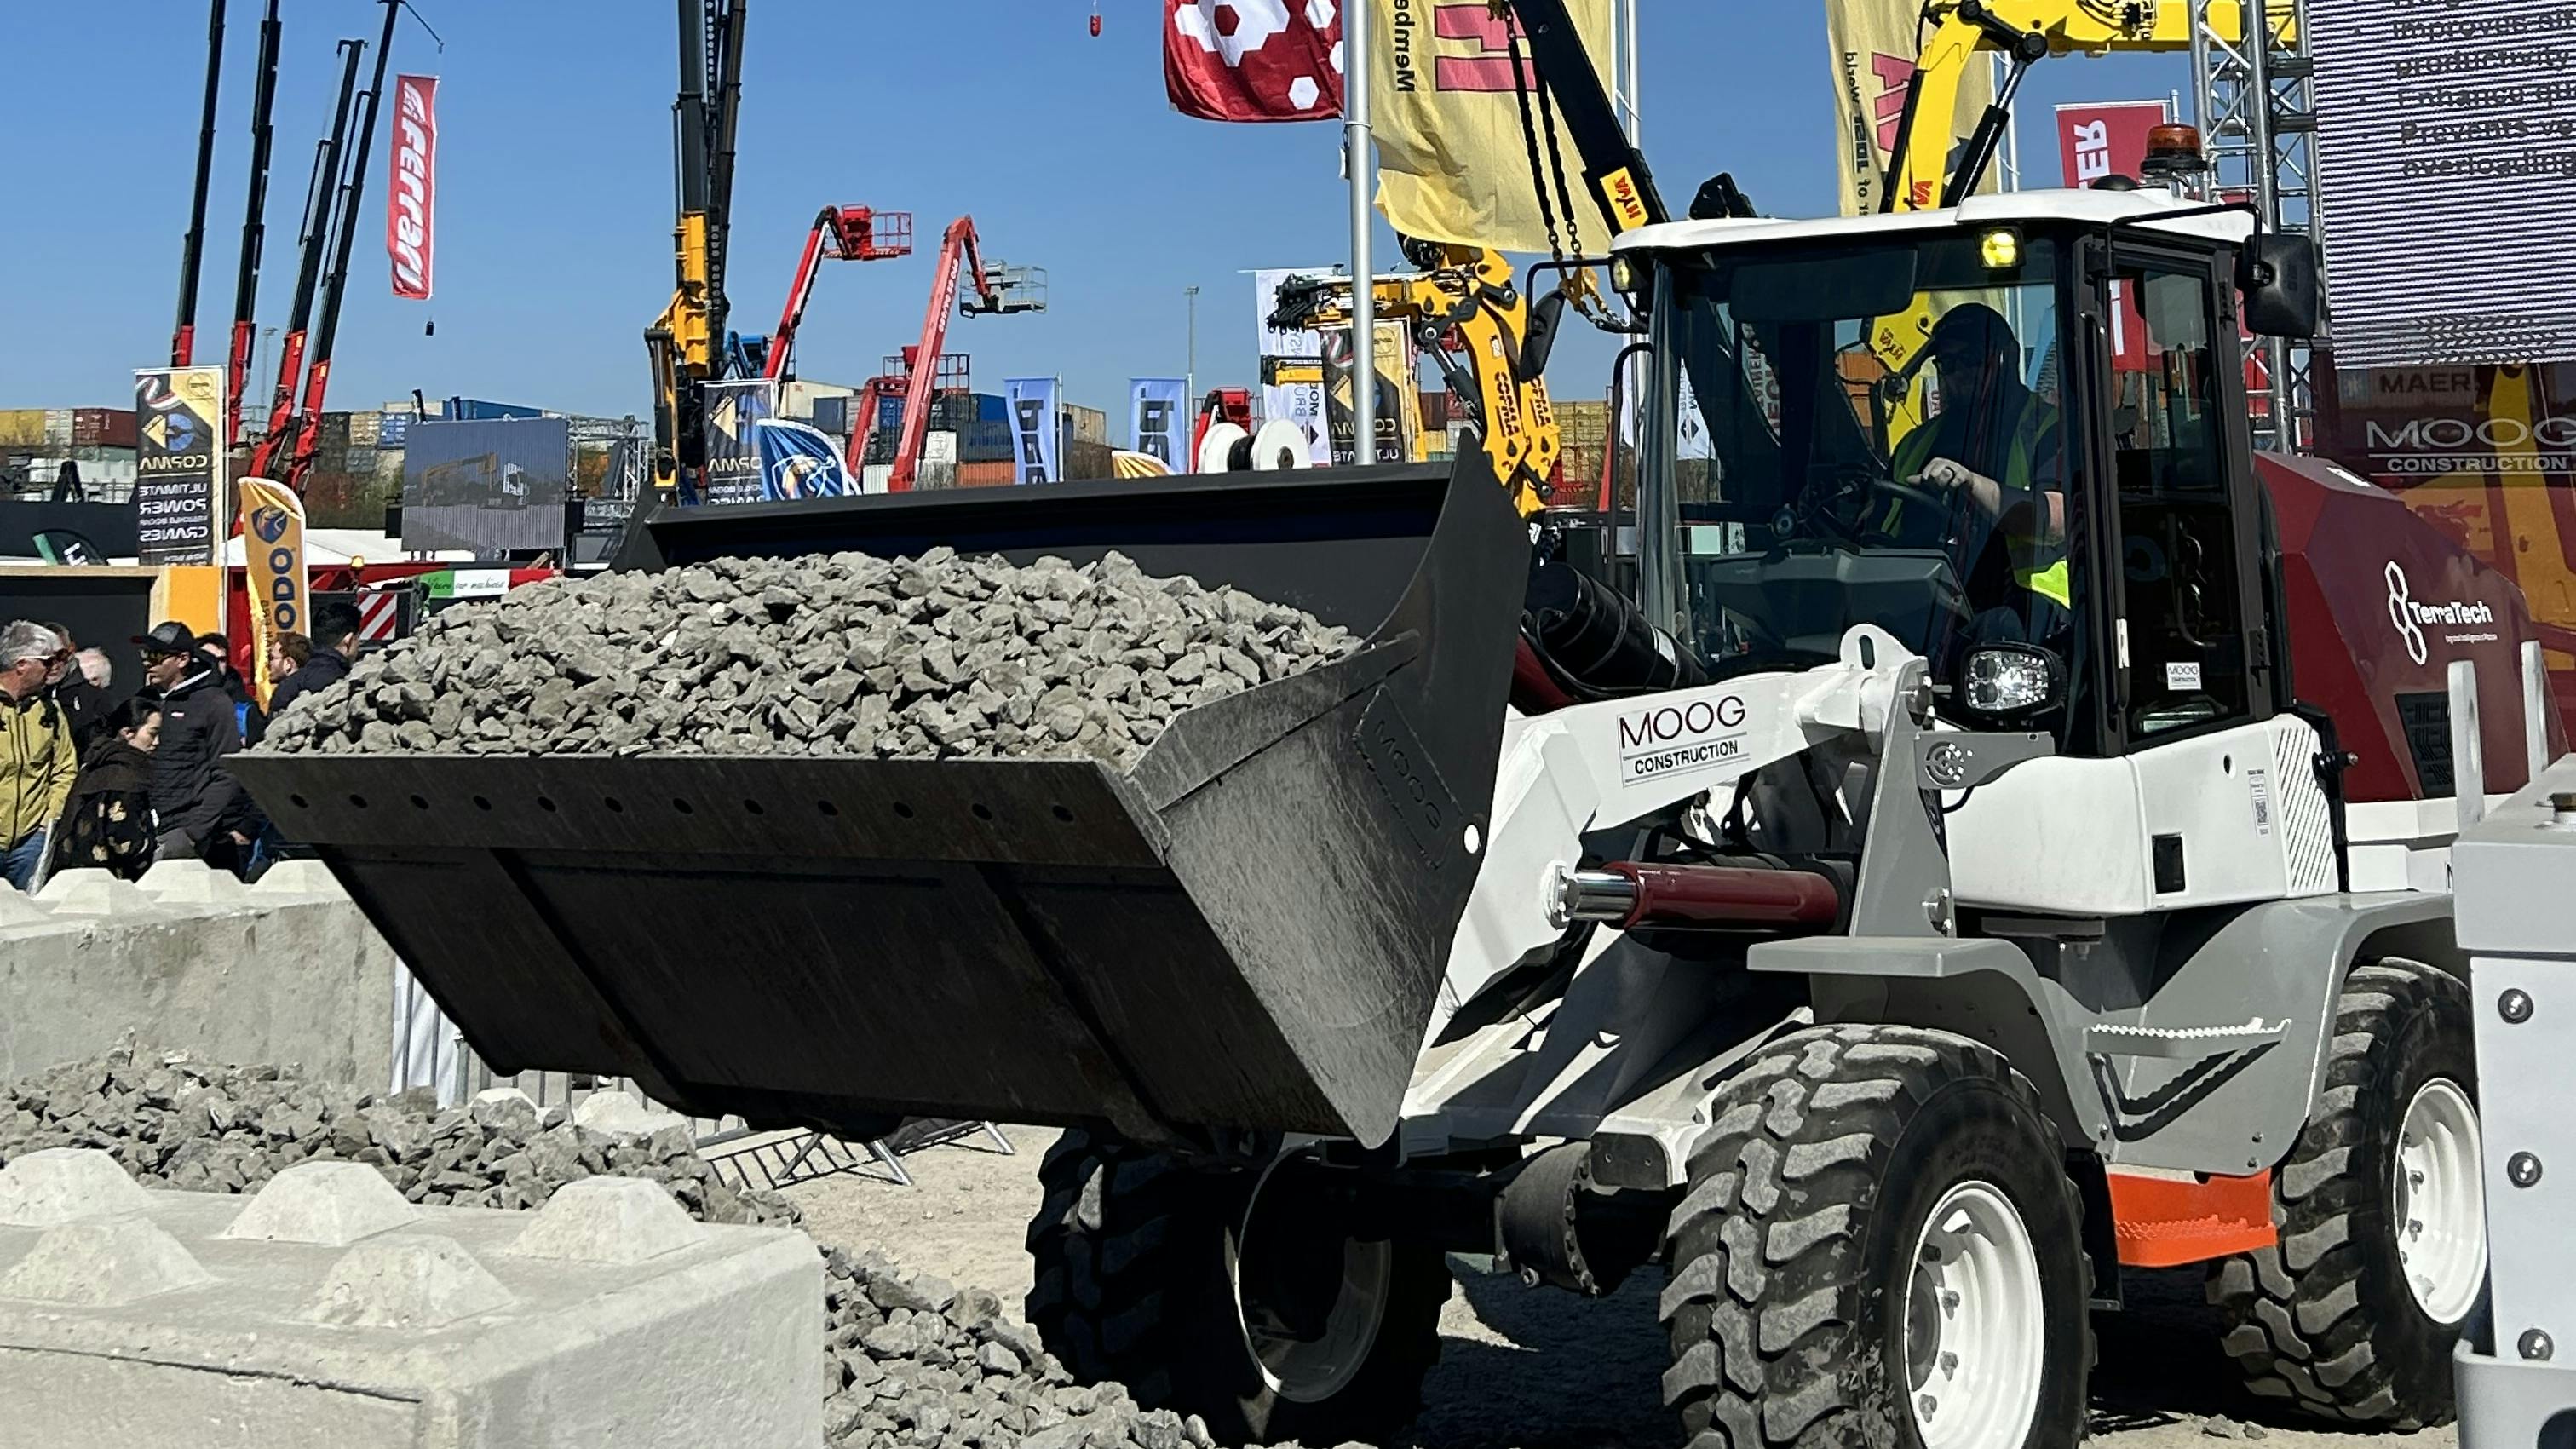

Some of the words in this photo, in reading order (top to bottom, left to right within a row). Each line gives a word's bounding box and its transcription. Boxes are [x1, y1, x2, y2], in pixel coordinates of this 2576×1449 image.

[2393, 17, 2527, 40] Improves
[2396, 49, 2569, 78] productivity
[2398, 84, 2523, 107] Enhance
[2401, 117, 2527, 145] Prevents
[2379, 372, 2479, 394] MAER
[2366, 417, 2576, 449] MOOG
[2387, 457, 2567, 471] CONSTRUCTION
[269, 548, 297, 635] ODO
[2407, 601, 2493, 624] TerraTech
[1619, 695, 1745, 749] MOOG
[1634, 739, 1739, 774] CONSTRUCTION
